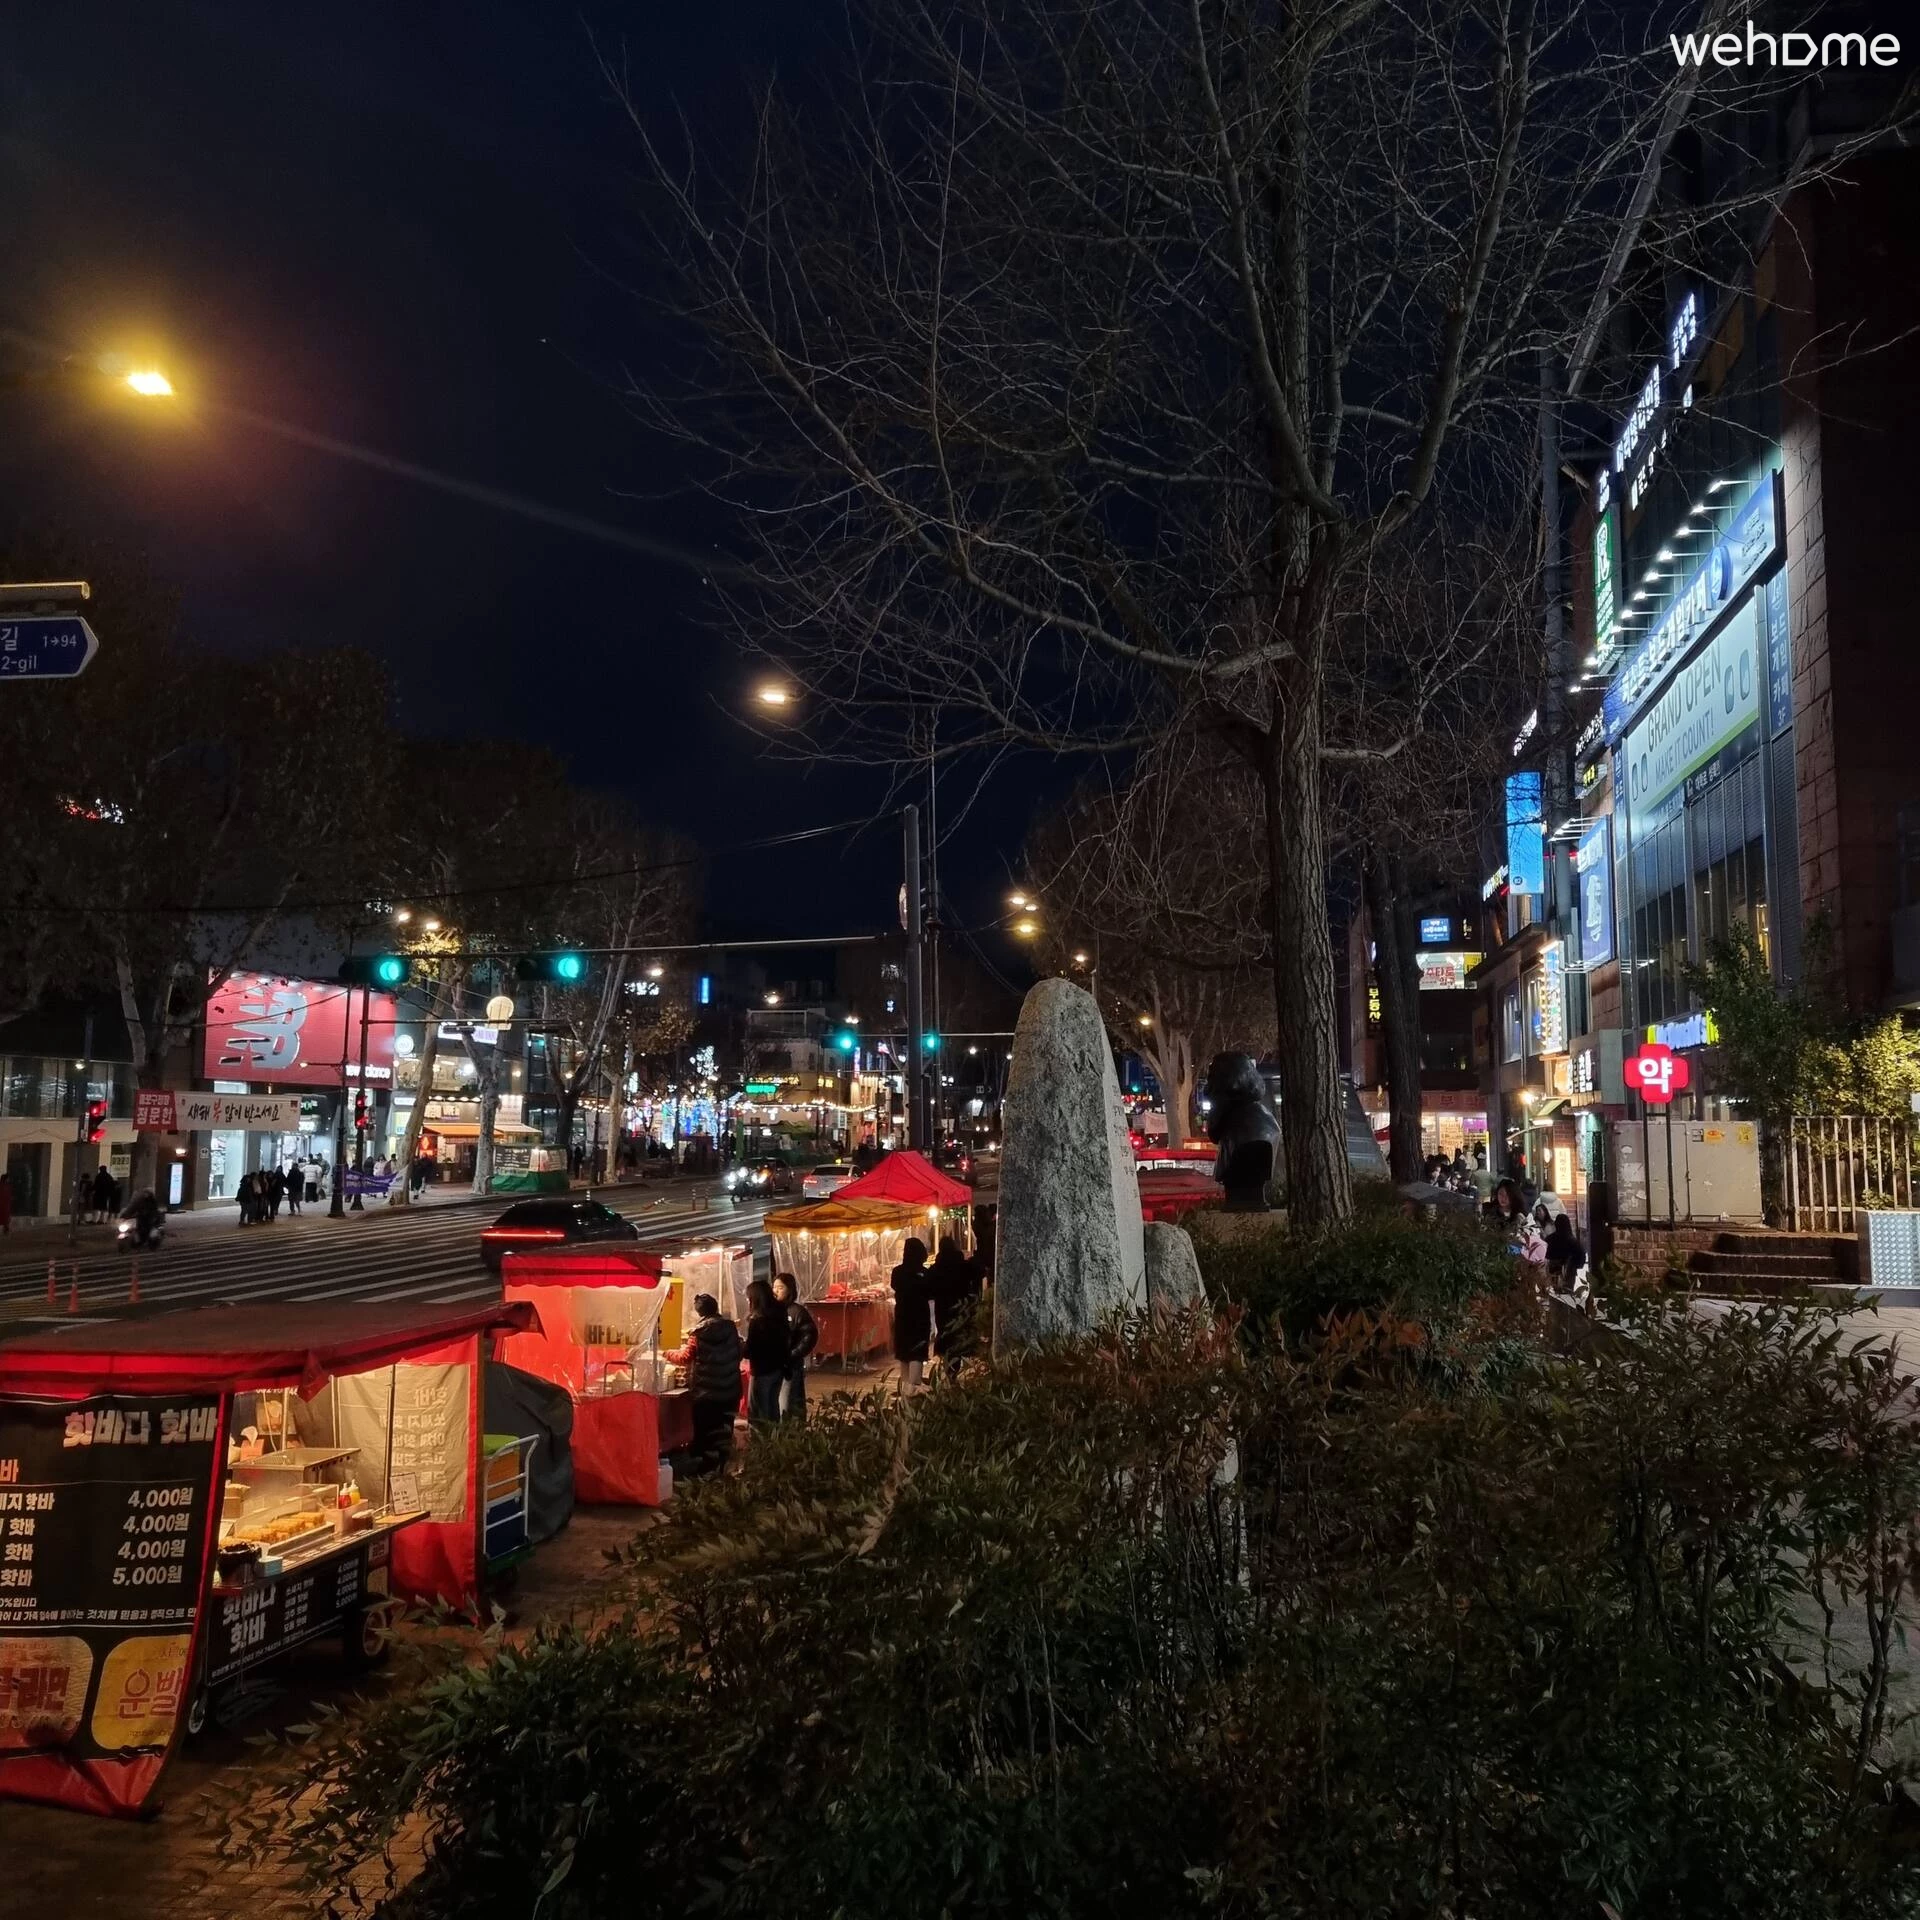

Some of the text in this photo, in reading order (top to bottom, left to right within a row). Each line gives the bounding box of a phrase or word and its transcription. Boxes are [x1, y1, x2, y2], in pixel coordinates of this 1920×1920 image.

[1, 626, 18, 651] 길
[1, 655, 37, 673] 2-gil
[1646, 681, 1682, 753] GRAND
[1685, 637, 1721, 712] OPEN
[1655, 750, 1673, 787] MAKE
[1674, 743, 1681, 770] IT
[1682, 706, 1715, 760] COUNT!
[1638, 1057, 1673, 1094] 약
[212, 1098, 223, 1123] 복
[244, 1103, 281, 1124] 받으세요
[63, 1407, 219, 1448] 핫바다 핫바
[25, 1492, 55, 1511] 핫바
[127, 1487, 194, 1509] 4,000원
[8, 1512, 190, 1536] 핫바 4,000원
[4, 1538, 186, 1562] 핫바 4,000원
[1, 1565, 183, 1587] 핫바 5,000원
[86, 1609, 117, 1621] 것처럼
